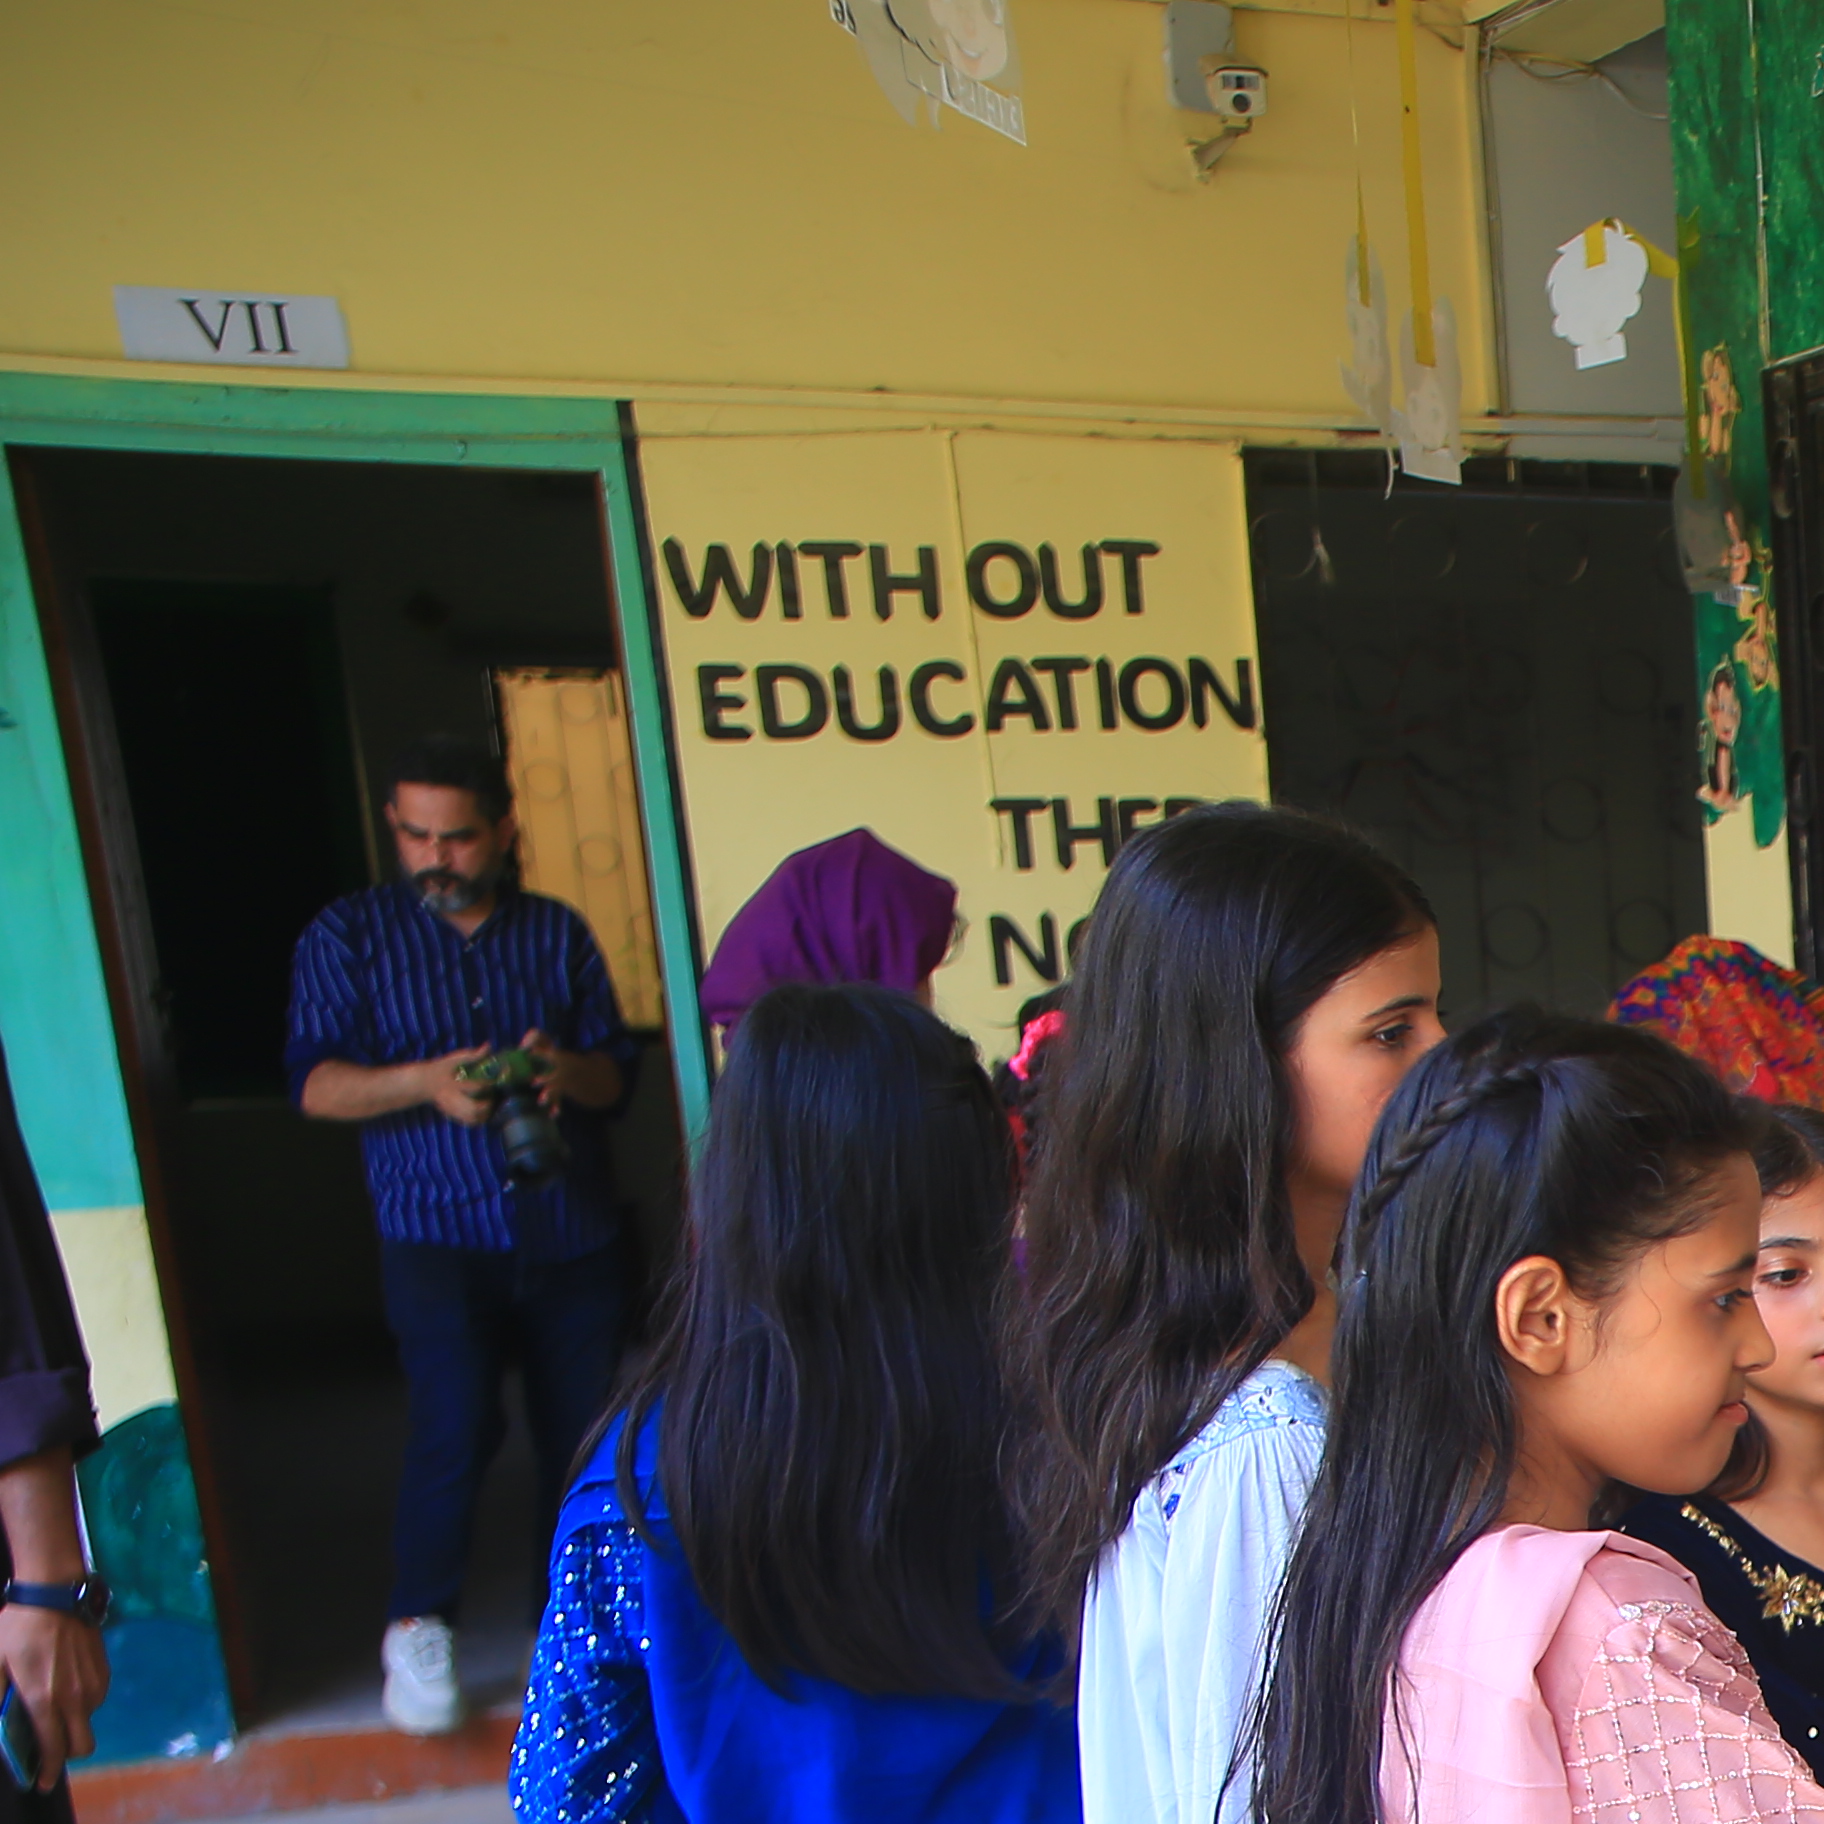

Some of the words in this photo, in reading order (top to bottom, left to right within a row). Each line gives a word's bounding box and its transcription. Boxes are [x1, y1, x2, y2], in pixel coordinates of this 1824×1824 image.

[179, 297, 300, 356] VII
[663, 534, 940, 621] WITH
[965, 539, 1160, 621] OUT
[697, 656, 1257, 742] EDUCATION
[990, 798, 1204, 870] THE
